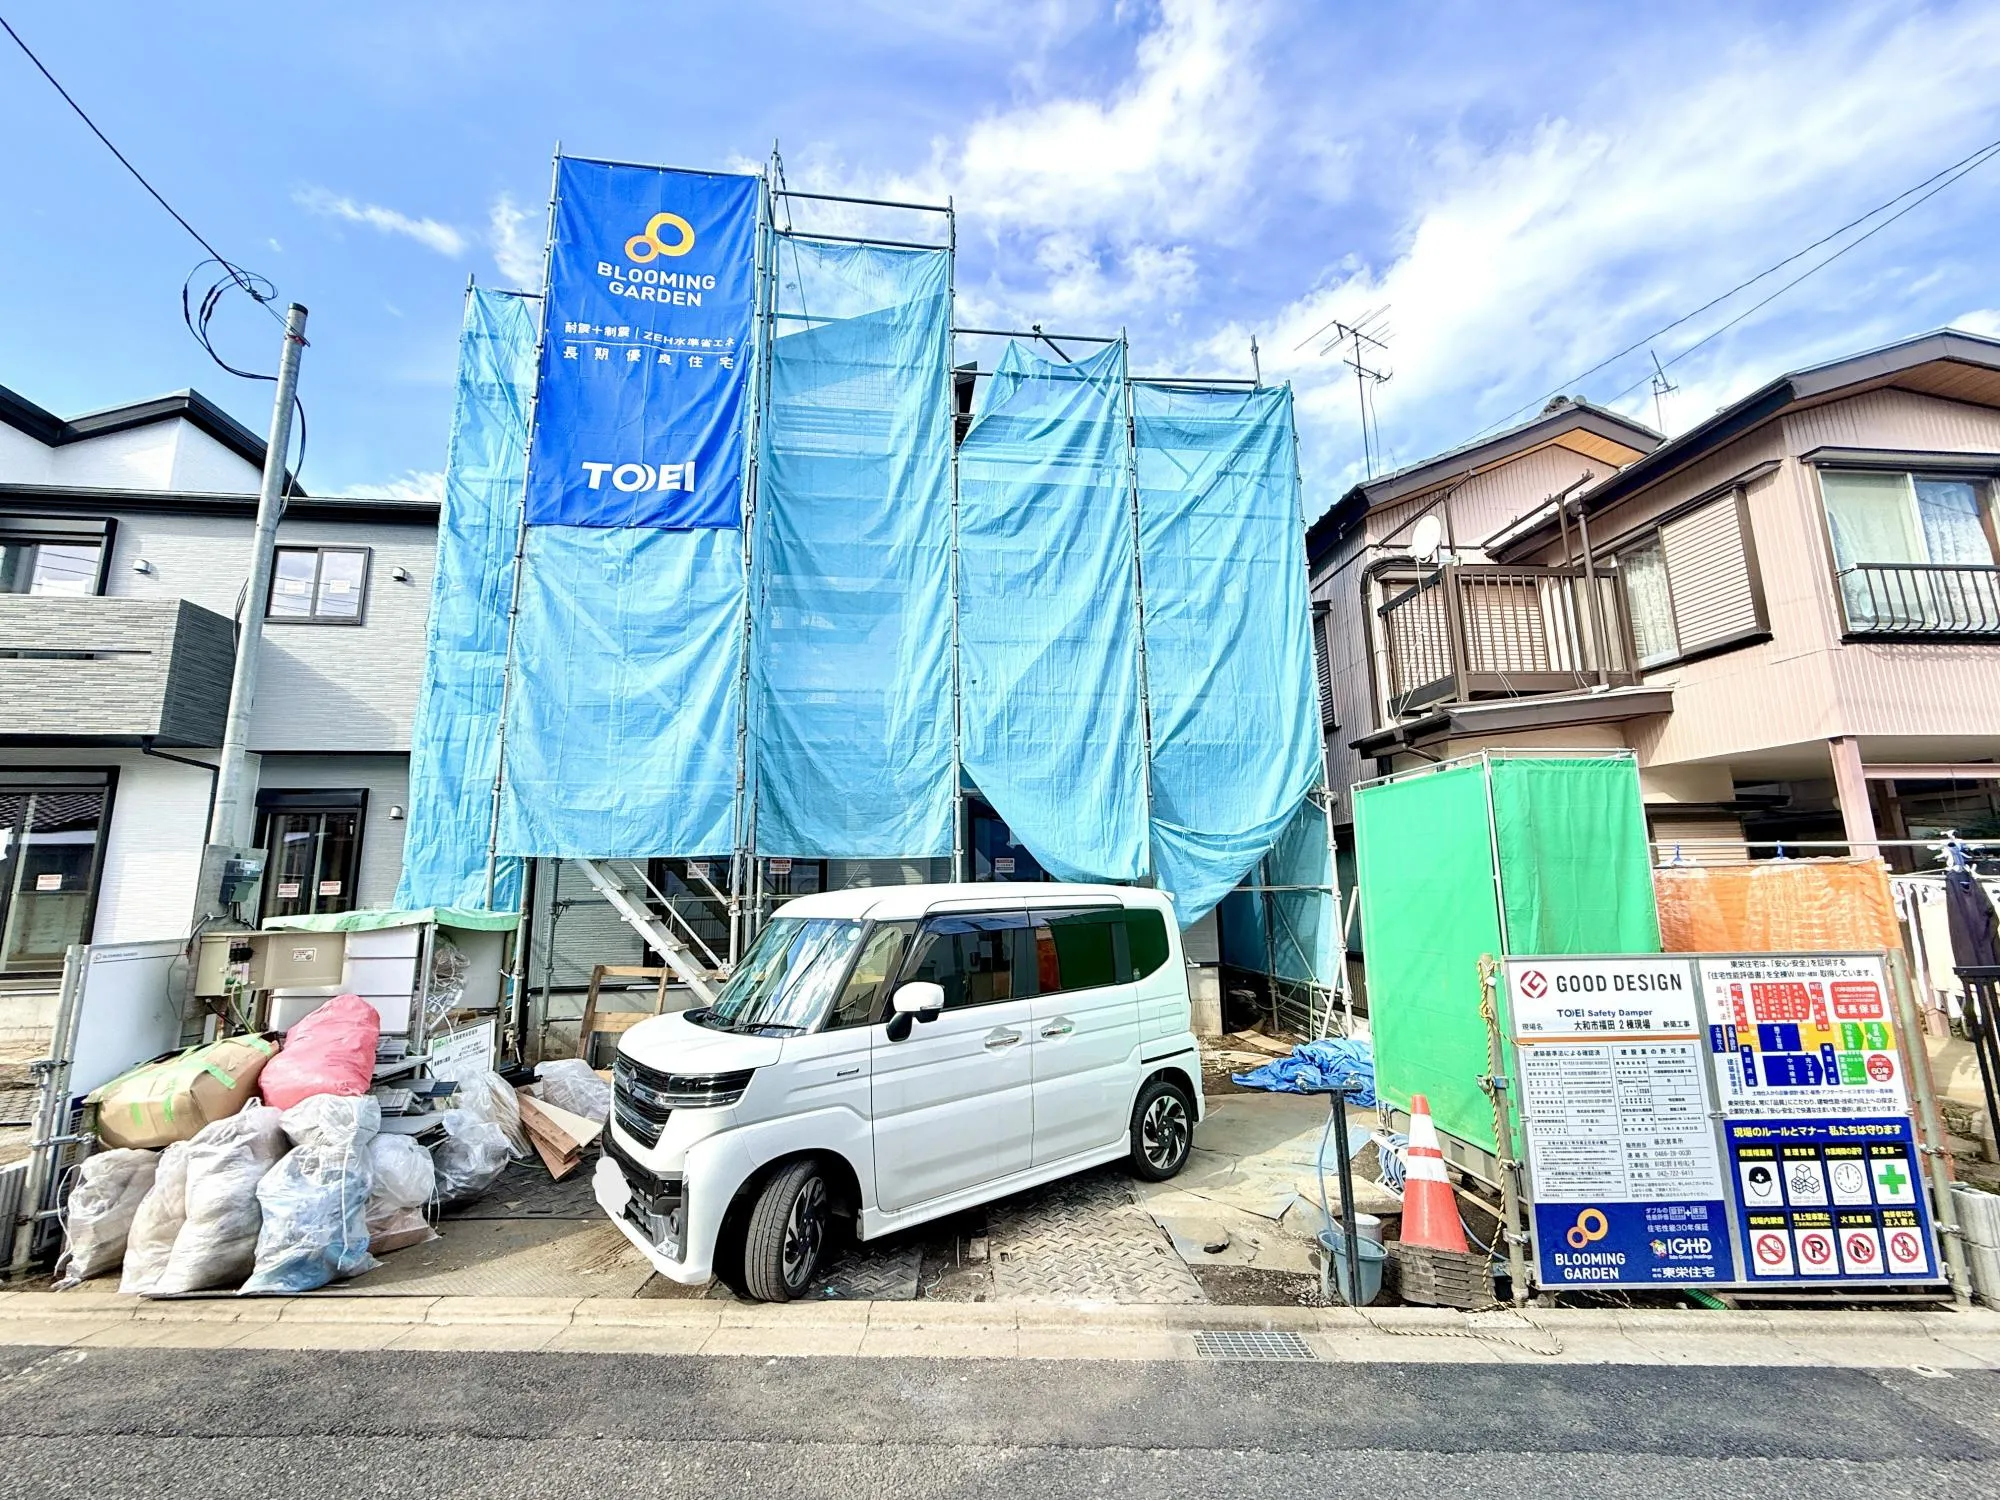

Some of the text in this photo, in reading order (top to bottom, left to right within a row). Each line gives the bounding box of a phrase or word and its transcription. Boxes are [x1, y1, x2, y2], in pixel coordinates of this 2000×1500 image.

[597, 261, 716, 291] BLOOMING
[608, 280, 702, 307] GARDEN
[1556, 973, 1683, 992] GOOD DESIGN
[1587, 1010, 1616, 1018] Safety
[1618, 1009, 1653, 1018] Damper
[1522, 1023, 1543, 1031] 現場名
[1733, 1125, 1902, 1137] 現場のルールとマナー 私たちは守ります
[1667, 1238, 1712, 1255] IGHD
[1555, 1252, 1626, 1265] BLOOMING
[1564, 1267, 1620, 1280] GARDEN
[1662, 1266, 1716, 1278] 東栄住宅
